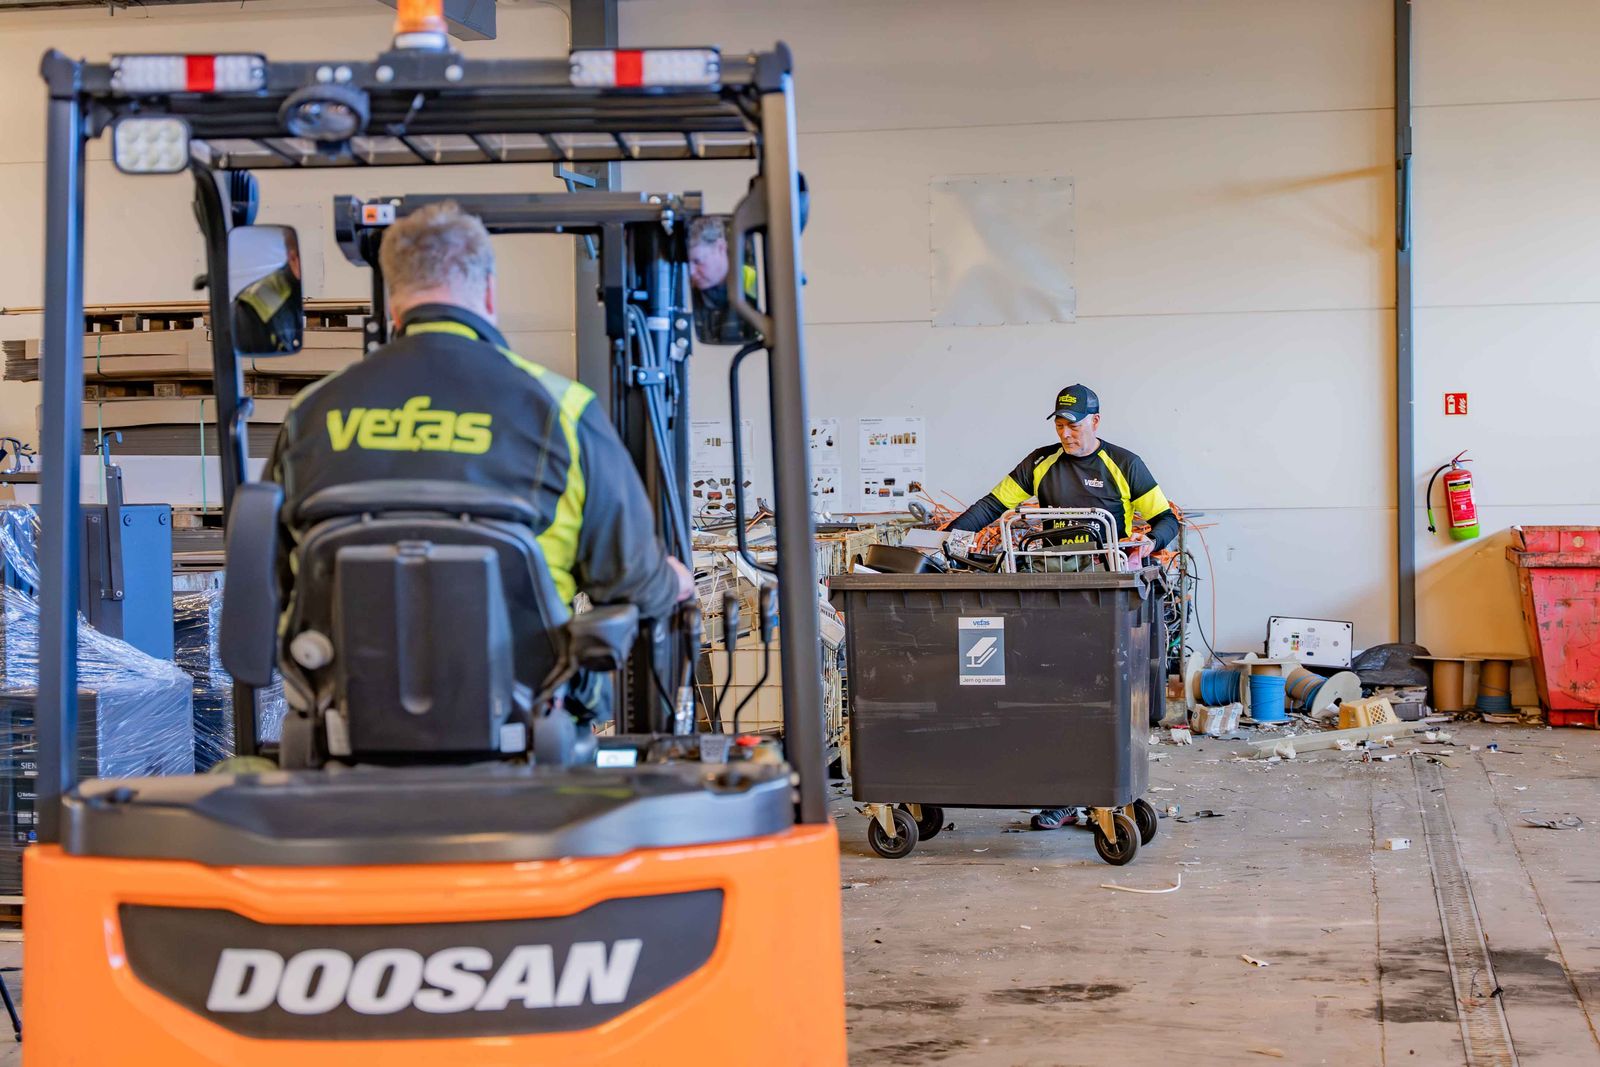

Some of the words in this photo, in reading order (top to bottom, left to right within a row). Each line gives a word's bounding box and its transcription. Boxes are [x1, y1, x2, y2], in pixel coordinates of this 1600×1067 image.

[325, 395, 494, 455] vefas
[1084, 478, 1104, 488] vefas
[206, 939, 642, 1014] DOOSAN
